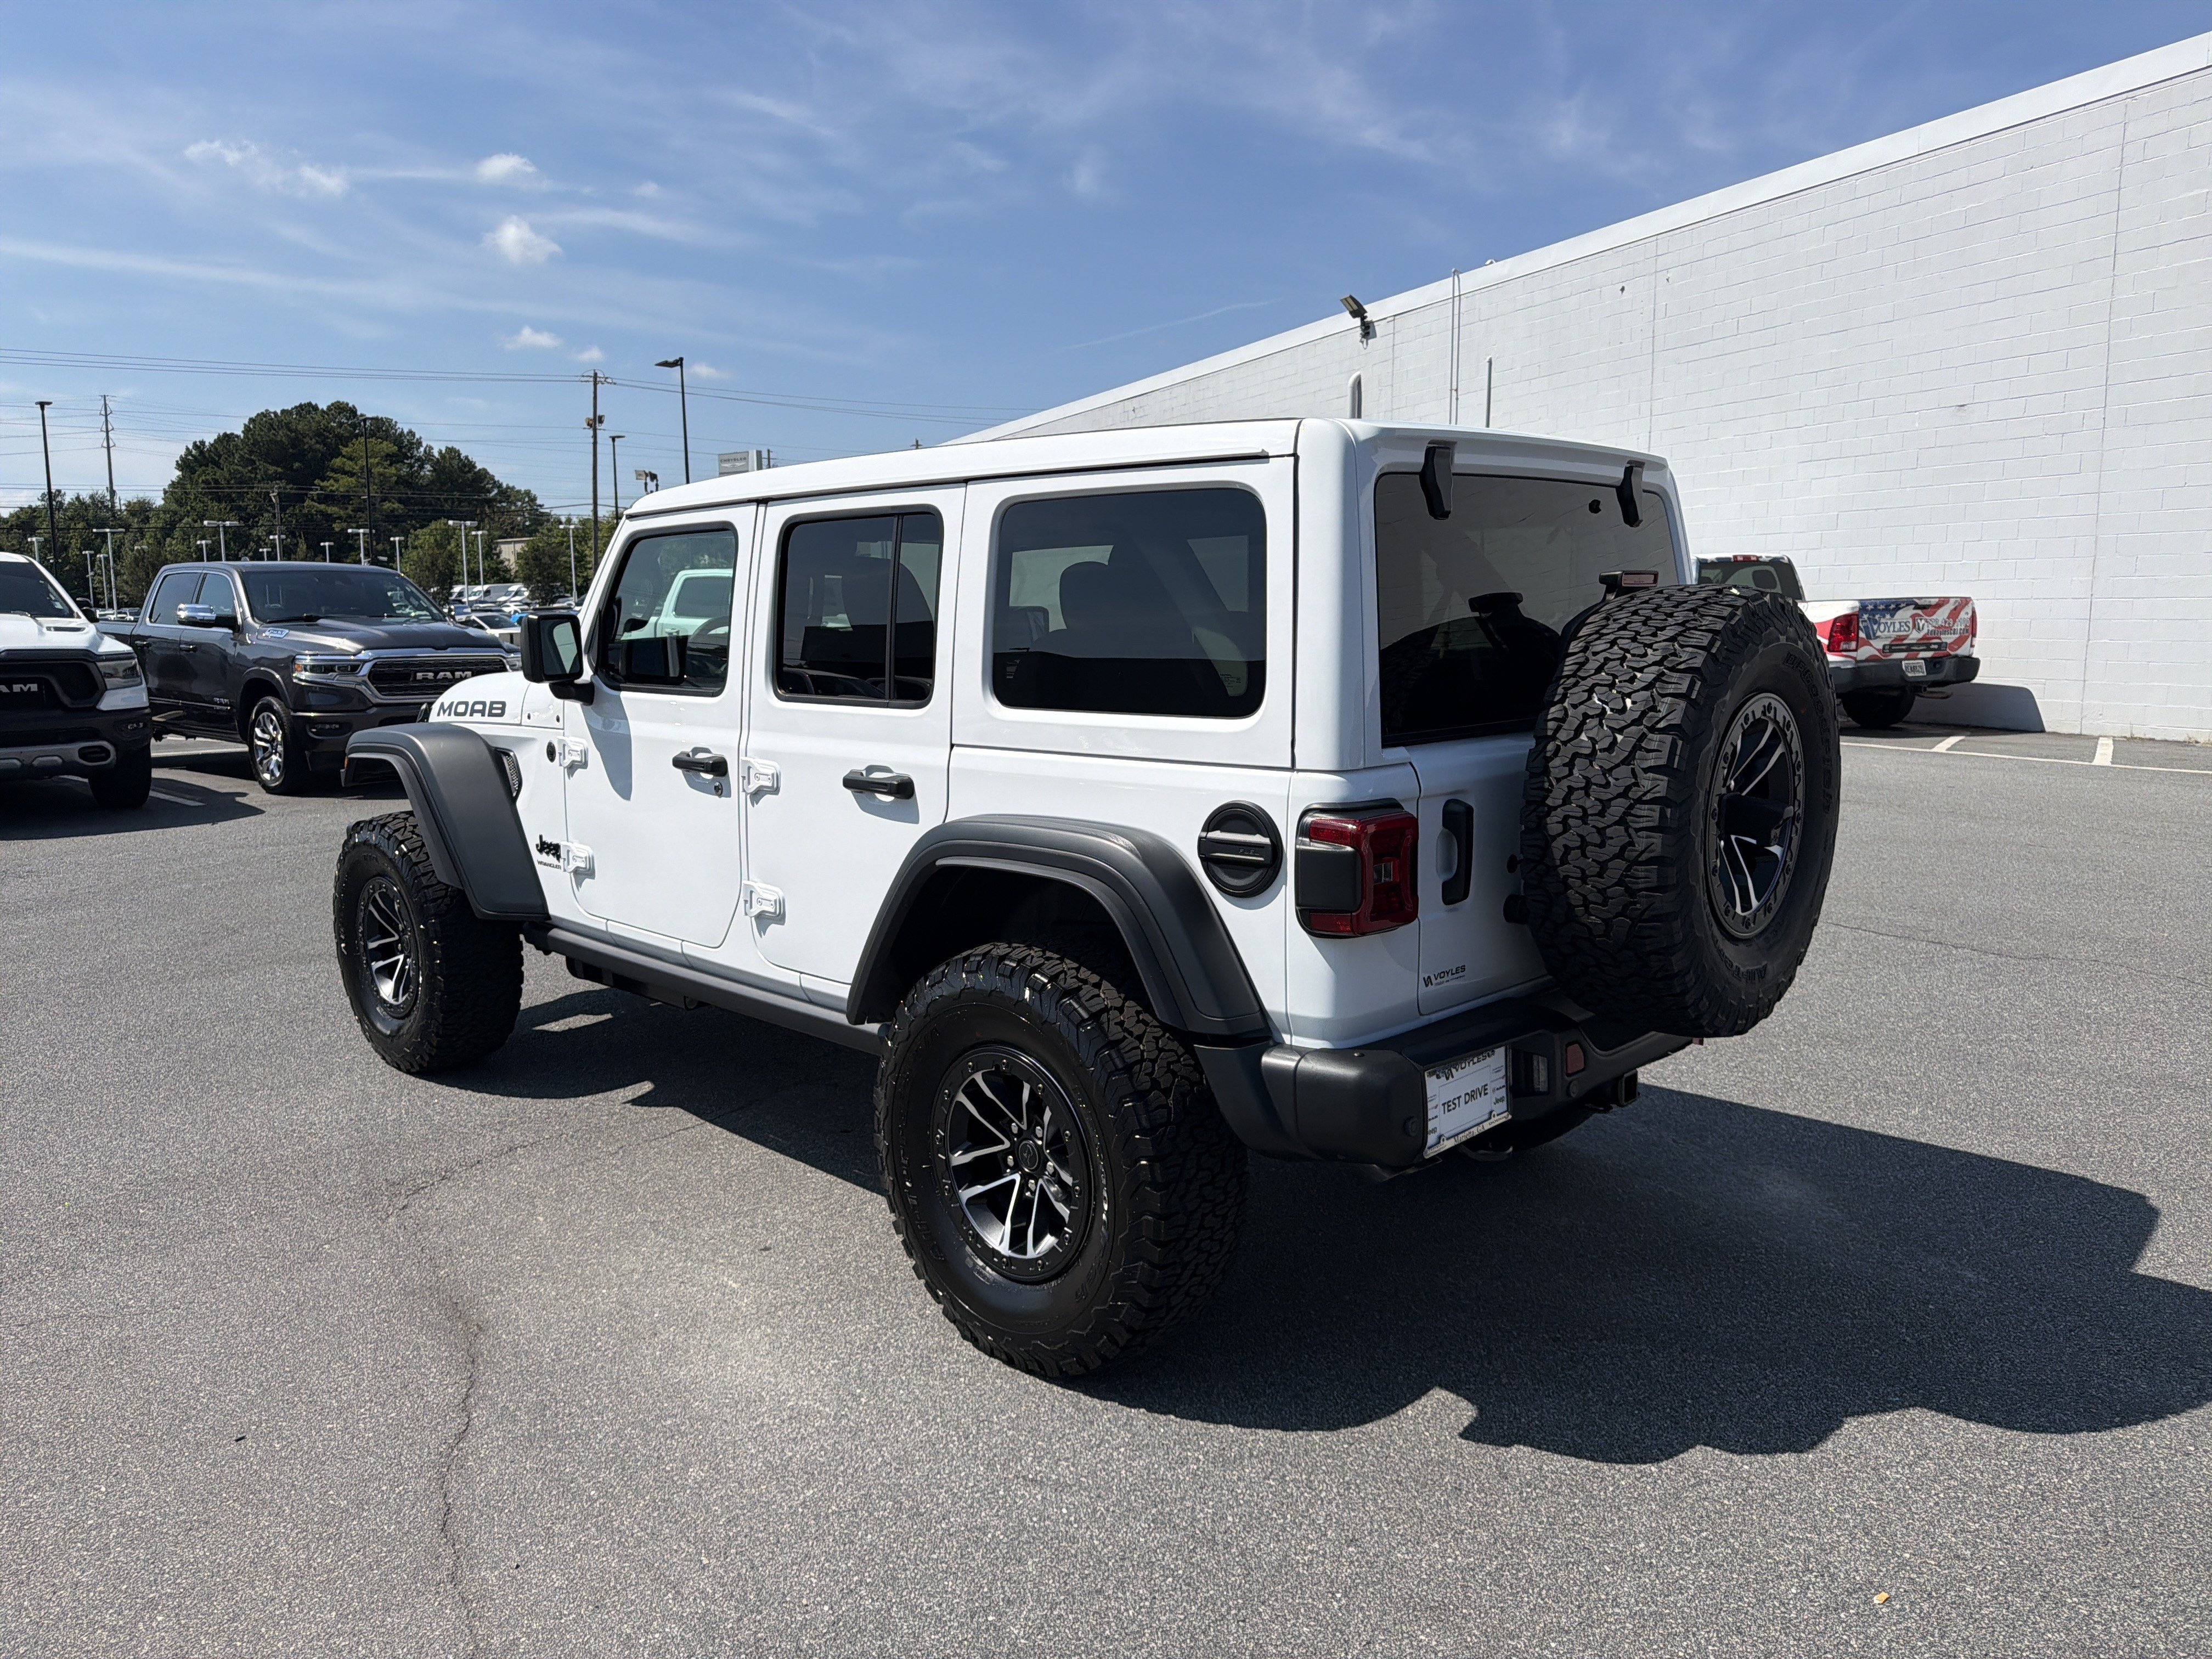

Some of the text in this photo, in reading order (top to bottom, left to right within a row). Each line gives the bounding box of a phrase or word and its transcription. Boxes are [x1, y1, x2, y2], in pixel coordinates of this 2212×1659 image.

[416, 671, 472, 680] RAM
[437, 701, 507, 717] MOAB
[535, 834, 561, 863] Jeep
[1433, 964, 1466, 980] VOYLES
[1453, 1051, 1487, 1072] VOYLES
[1441, 1095, 1462, 1115] TEST
[1464, 1083, 1489, 1105] DRIVE
[1493, 1096, 1505, 1105] Jeep
[1427, 1126, 1437, 1135] eep
[1476, 1124, 1486, 1133] GA
